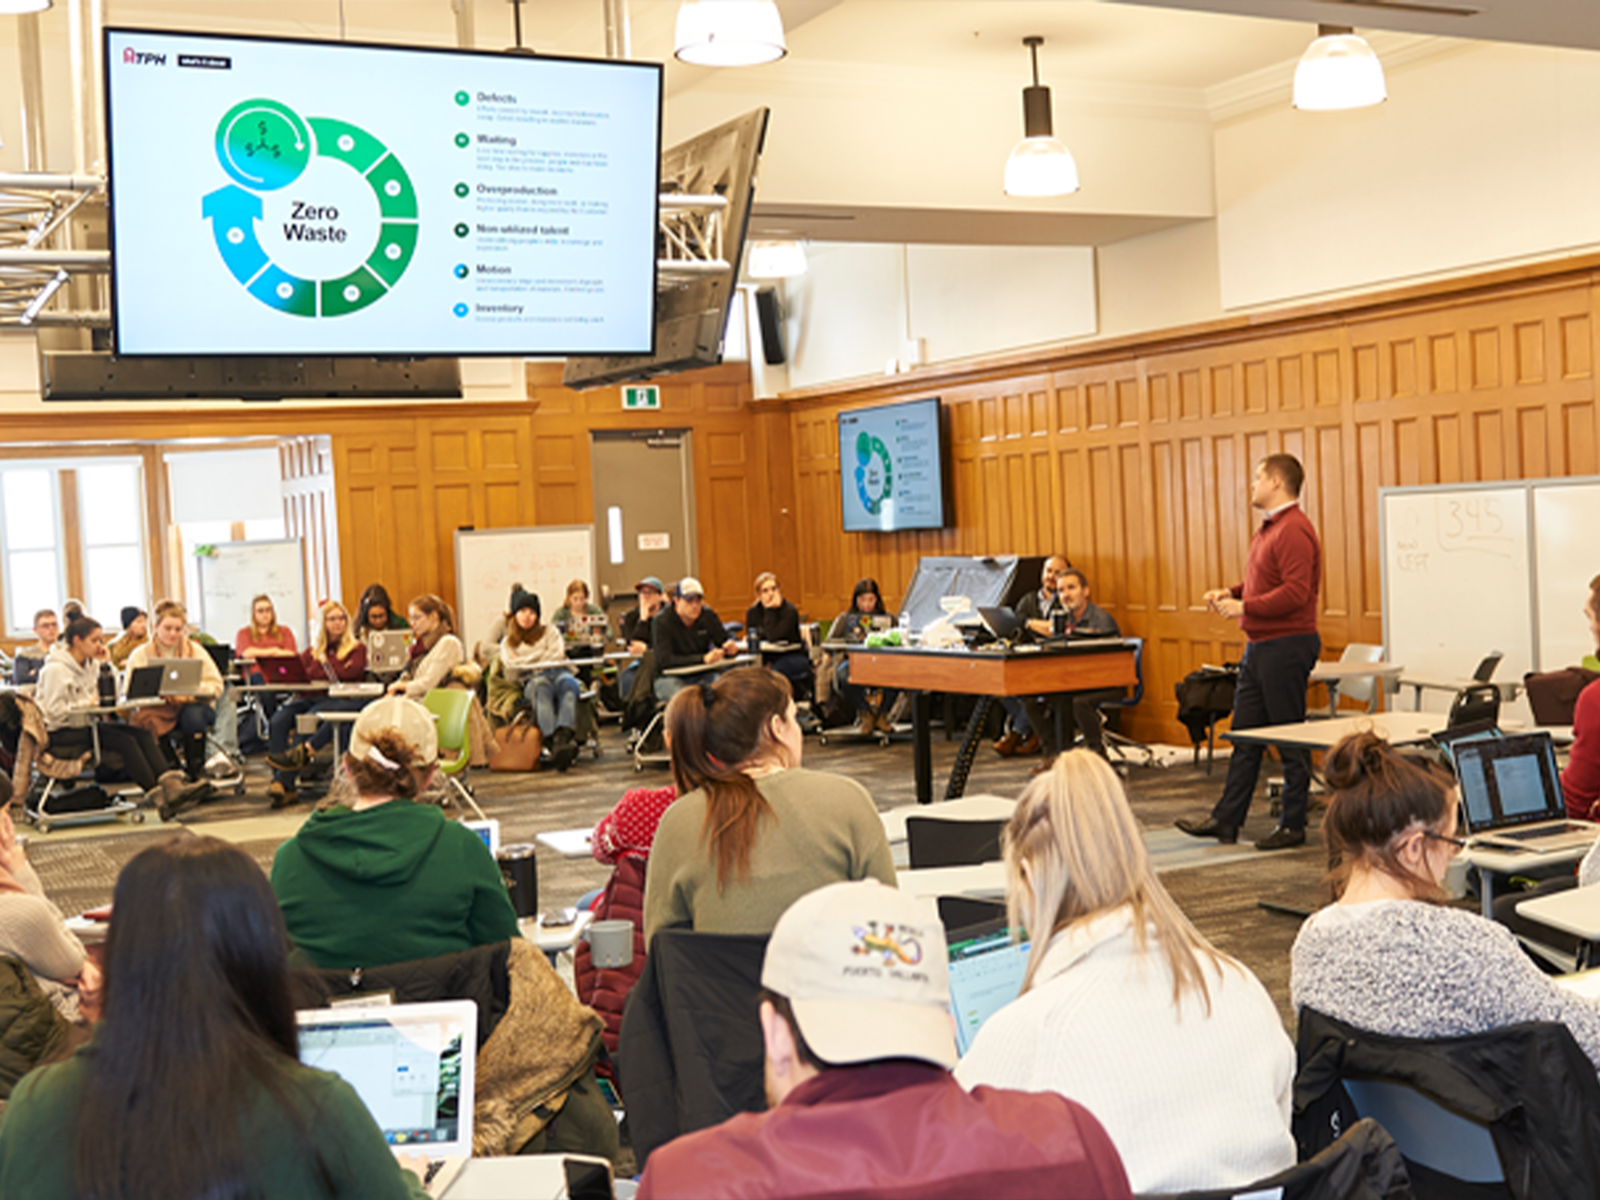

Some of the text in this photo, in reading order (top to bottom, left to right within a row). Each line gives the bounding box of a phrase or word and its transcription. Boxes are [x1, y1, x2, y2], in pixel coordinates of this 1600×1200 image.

[476, 134, 517, 148] Waiting
[476, 183, 558, 197] Overproduction
[291, 200, 340, 221] Zero
[282, 222, 348, 244] Waste
[476, 264, 512, 274] Motion
[475, 303, 524, 314] Inventory
